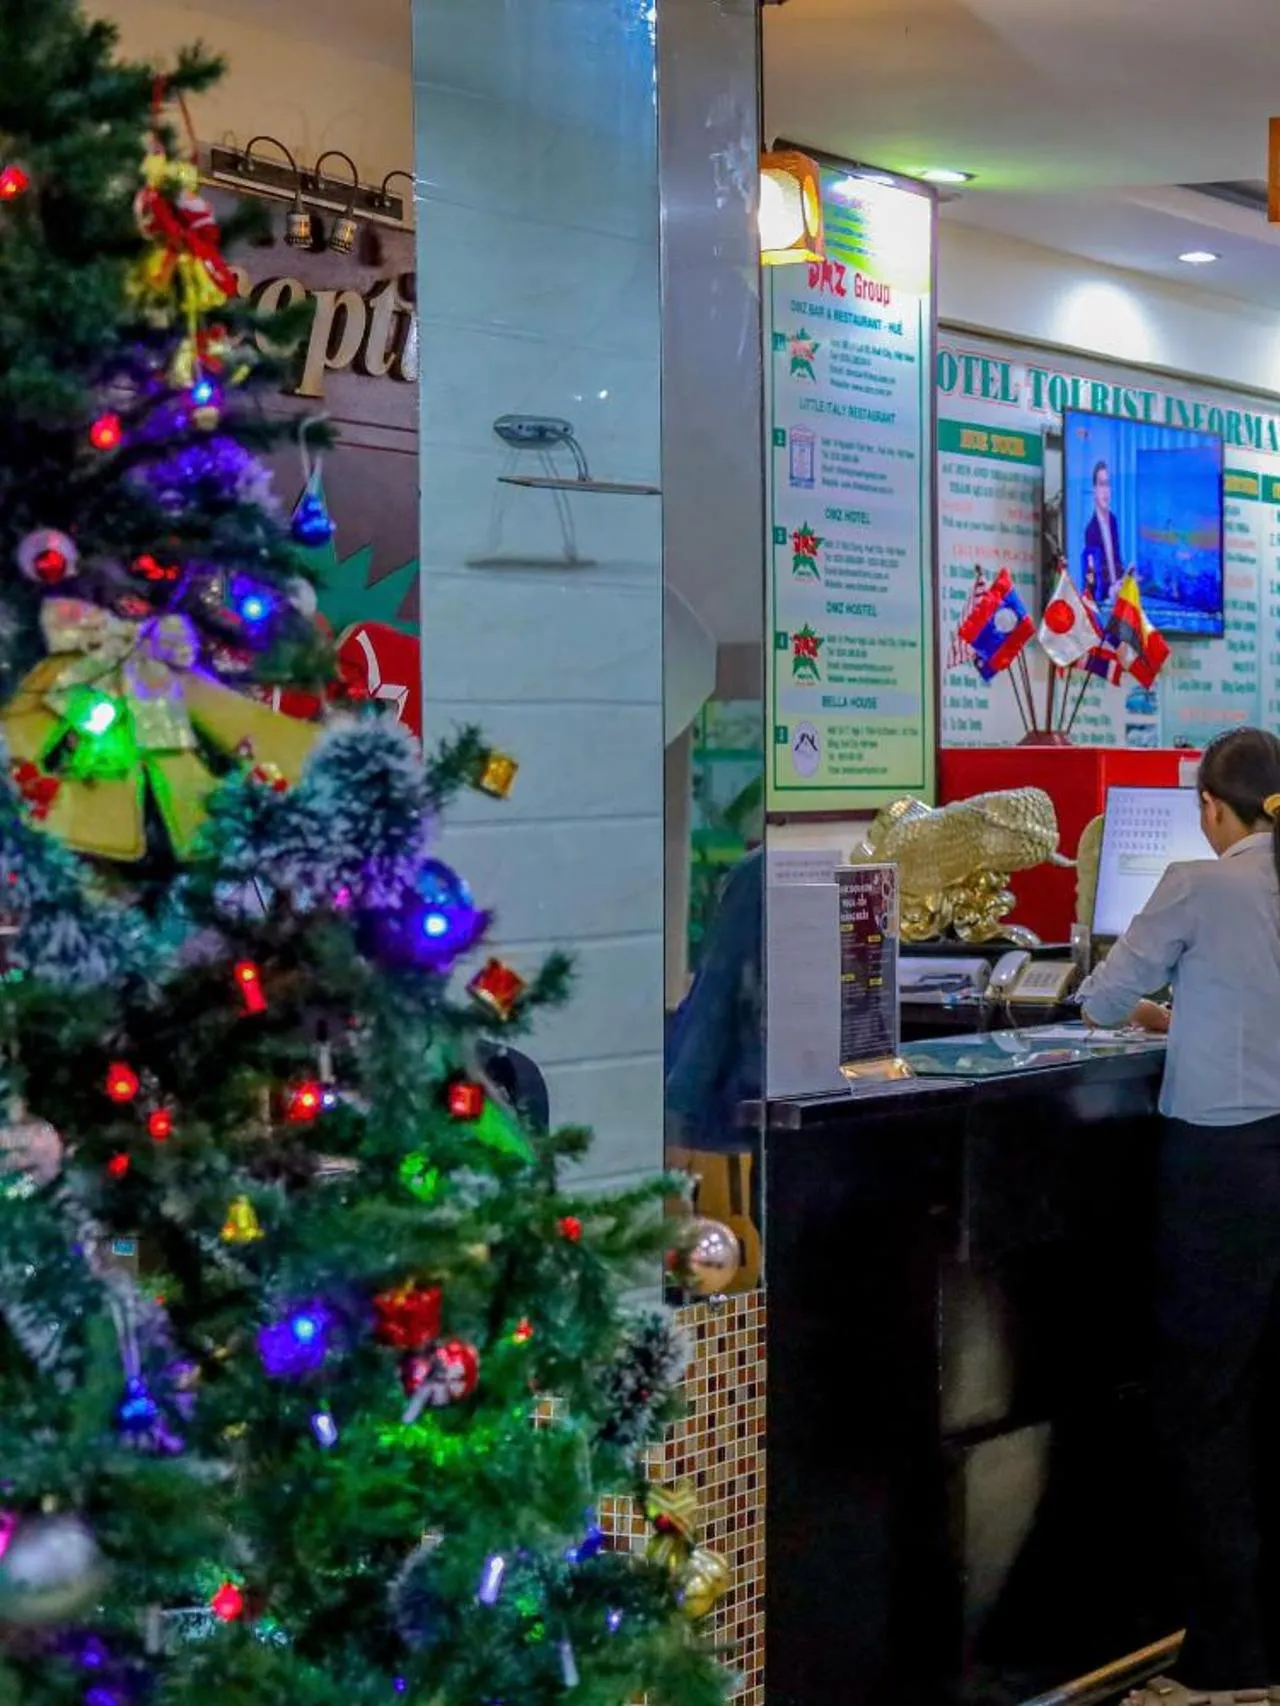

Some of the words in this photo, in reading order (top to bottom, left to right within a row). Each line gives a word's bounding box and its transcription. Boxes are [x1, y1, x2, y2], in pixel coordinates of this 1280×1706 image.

[854, 273, 891, 307] Group
[833, 309, 882, 330] RESTAURANT
[937, 351, 1018, 403] OTEL
[1029, 367, 1157, 422] TOURIST
[800, 398, 825, 413] LITTLE
[848, 403, 897, 425] RESTAURANT
[822, 695, 847, 710] BELLA
